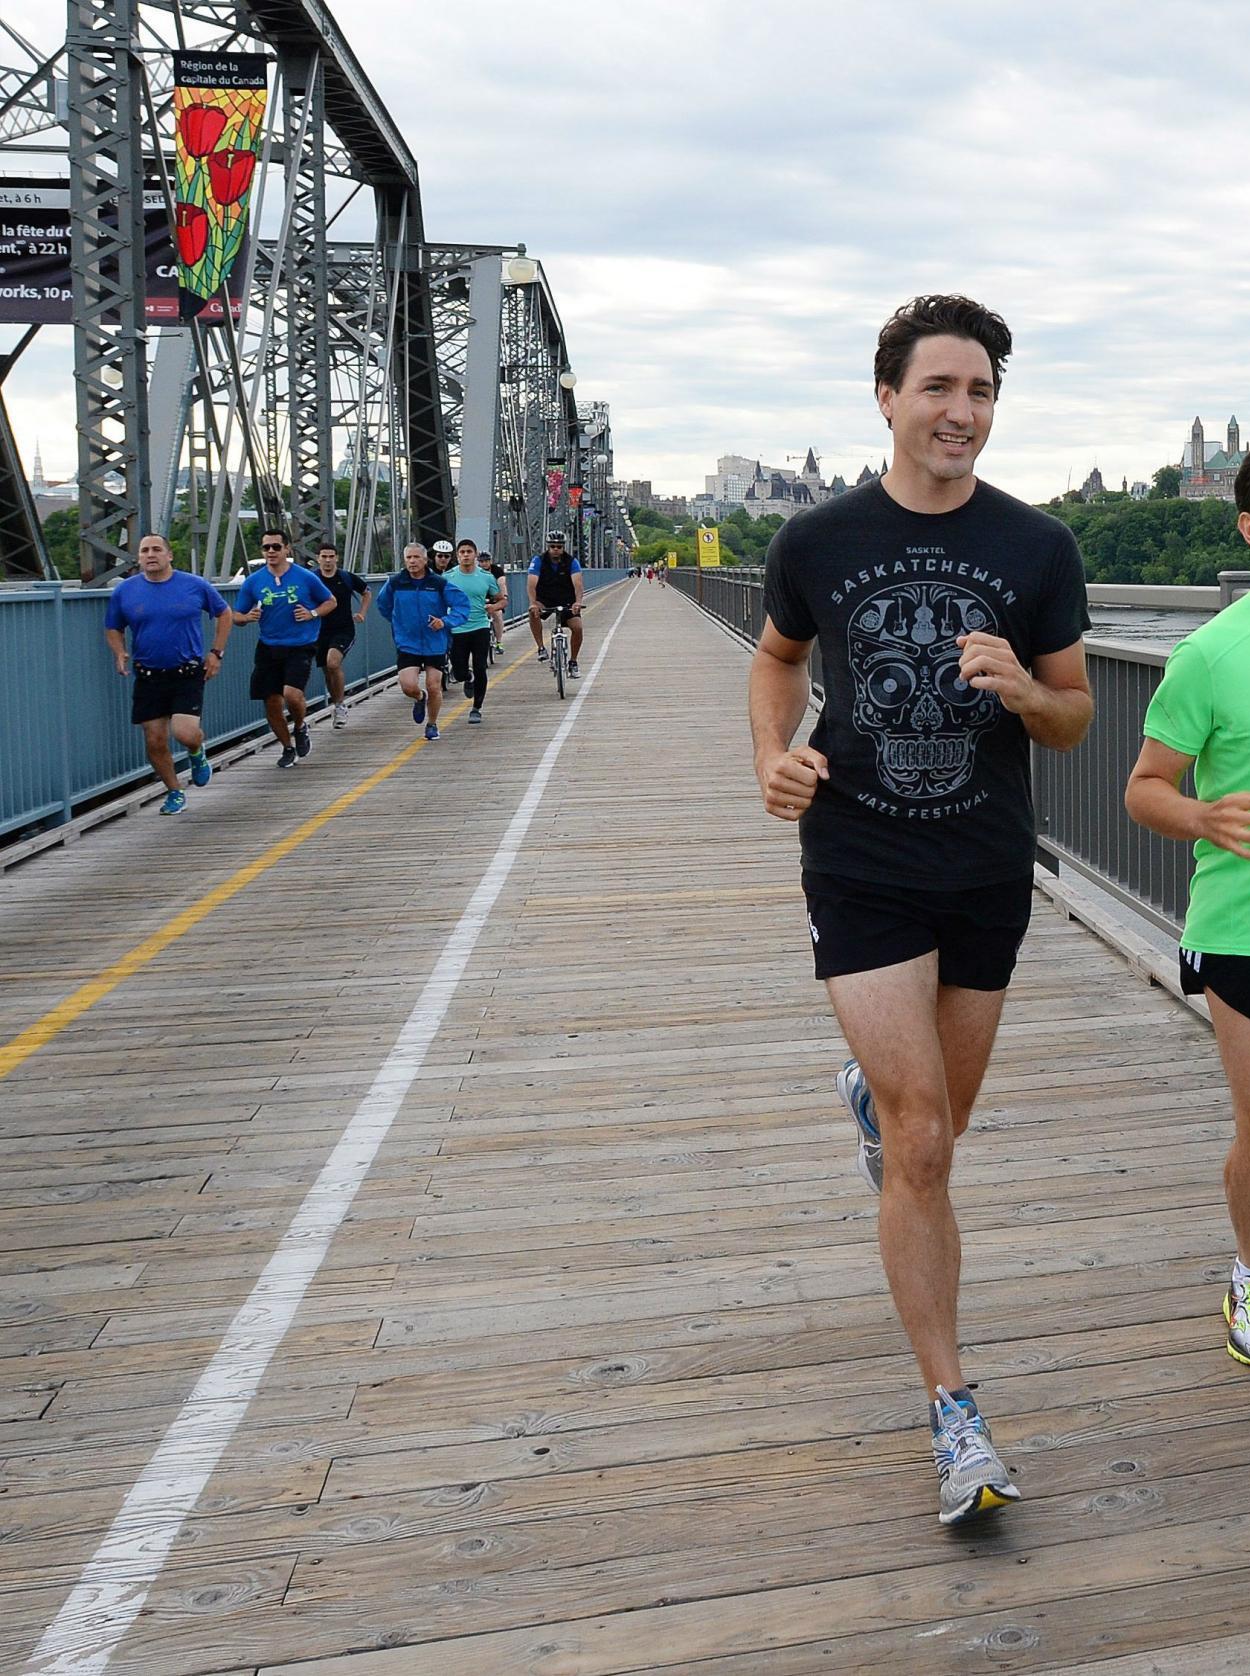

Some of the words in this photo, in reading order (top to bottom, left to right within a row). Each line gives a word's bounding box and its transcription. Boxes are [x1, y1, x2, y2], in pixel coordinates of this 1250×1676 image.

[180, 60, 213, 71] Région
[215, 62, 228, 71] de
[229, 62, 239, 71] la
[181, 75, 217, 84] capitale
[219, 75, 230, 84] du
[232, 76, 265, 85] Canada
[15, 193, 21, 203] à
[24, 194, 32, 203] 6
[34, 194, 41, 204] h
[2, 224, 15, 236] la
[17, 225, 45, 237] fête
[46, 226, 64, 237] du
[28, 242, 38, 254] à
[40, 243, 57, 254] 22
[58, 243, 68, 254] h
[0, 284, 41, 300] orks,
[44, 287, 60, 299] 10
[905, 546, 946, 555] SASKTEL
[831, 558, 1017, 605] SASKATCHEWAN
[857, 793, 898, 817] JAZZ
[908, 790, 989, 819] FESTIVAL
